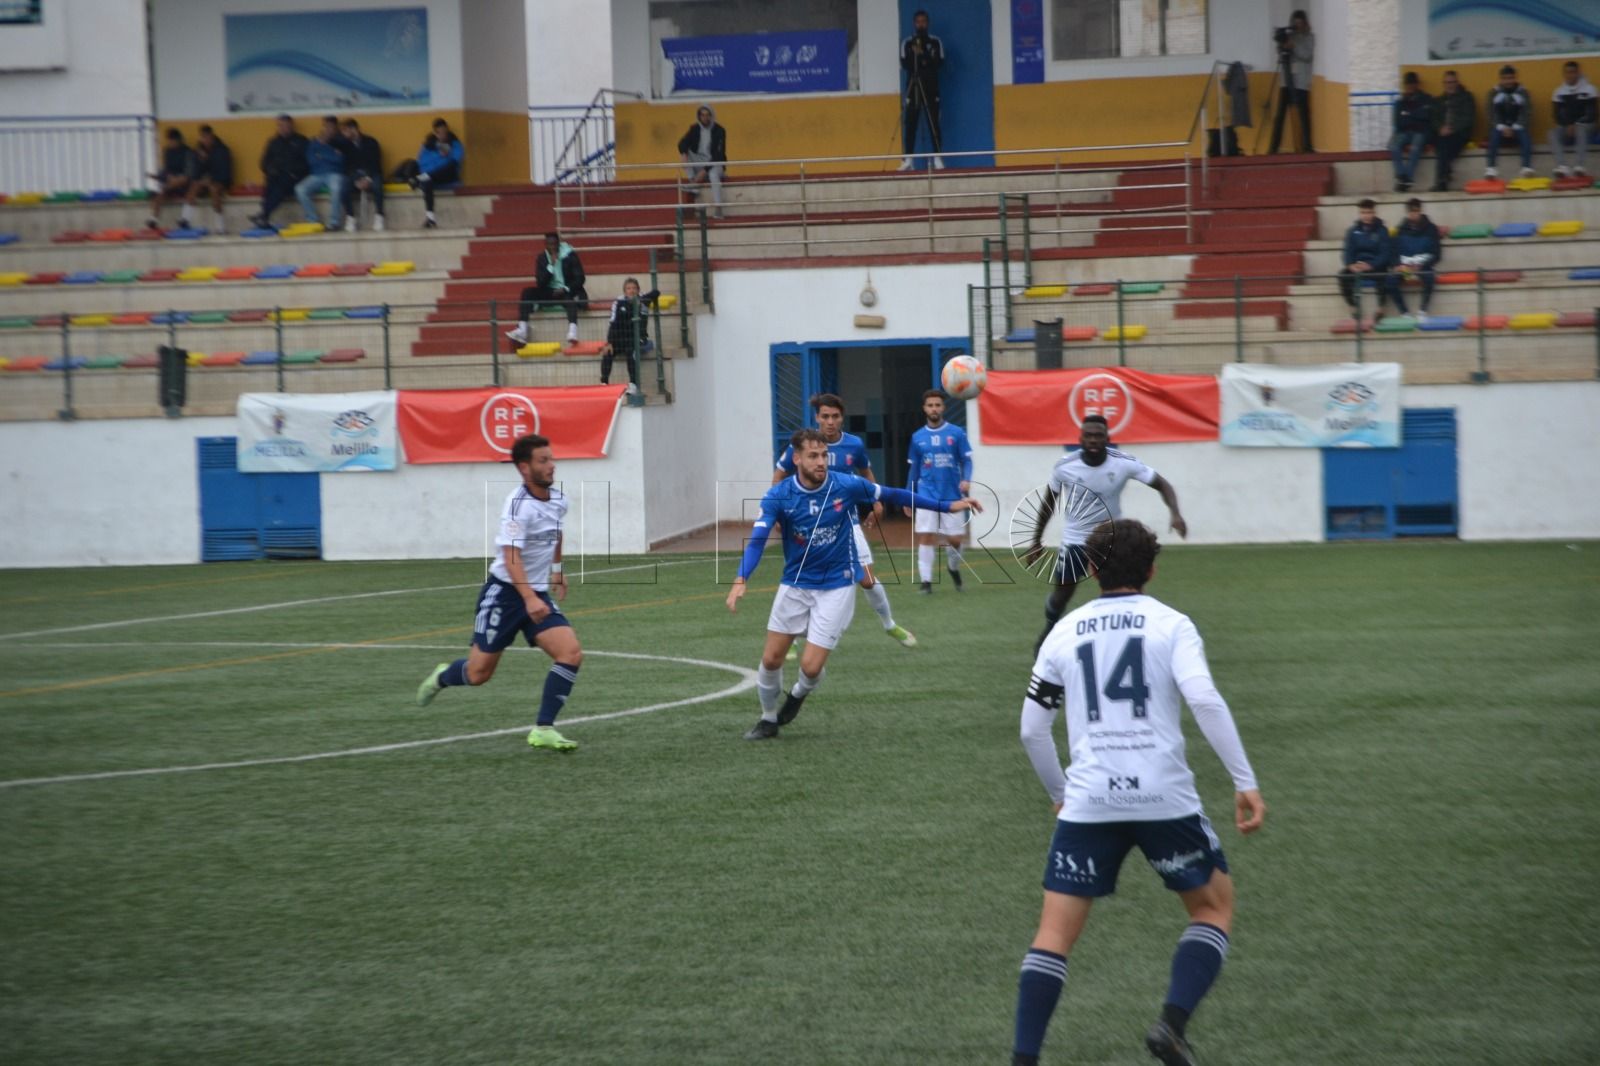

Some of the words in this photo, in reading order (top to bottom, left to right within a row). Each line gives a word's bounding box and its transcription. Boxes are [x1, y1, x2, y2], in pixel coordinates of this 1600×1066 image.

[494, 407, 526, 420] RF
[495, 425, 527, 438] EF
[331, 443, 379, 455] Melilla
[809, 500, 819, 515] 6
[489, 608, 502, 627] 6
[1076, 611, 1146, 635] ORTUÑO
[1075, 635, 1151, 723] 14
